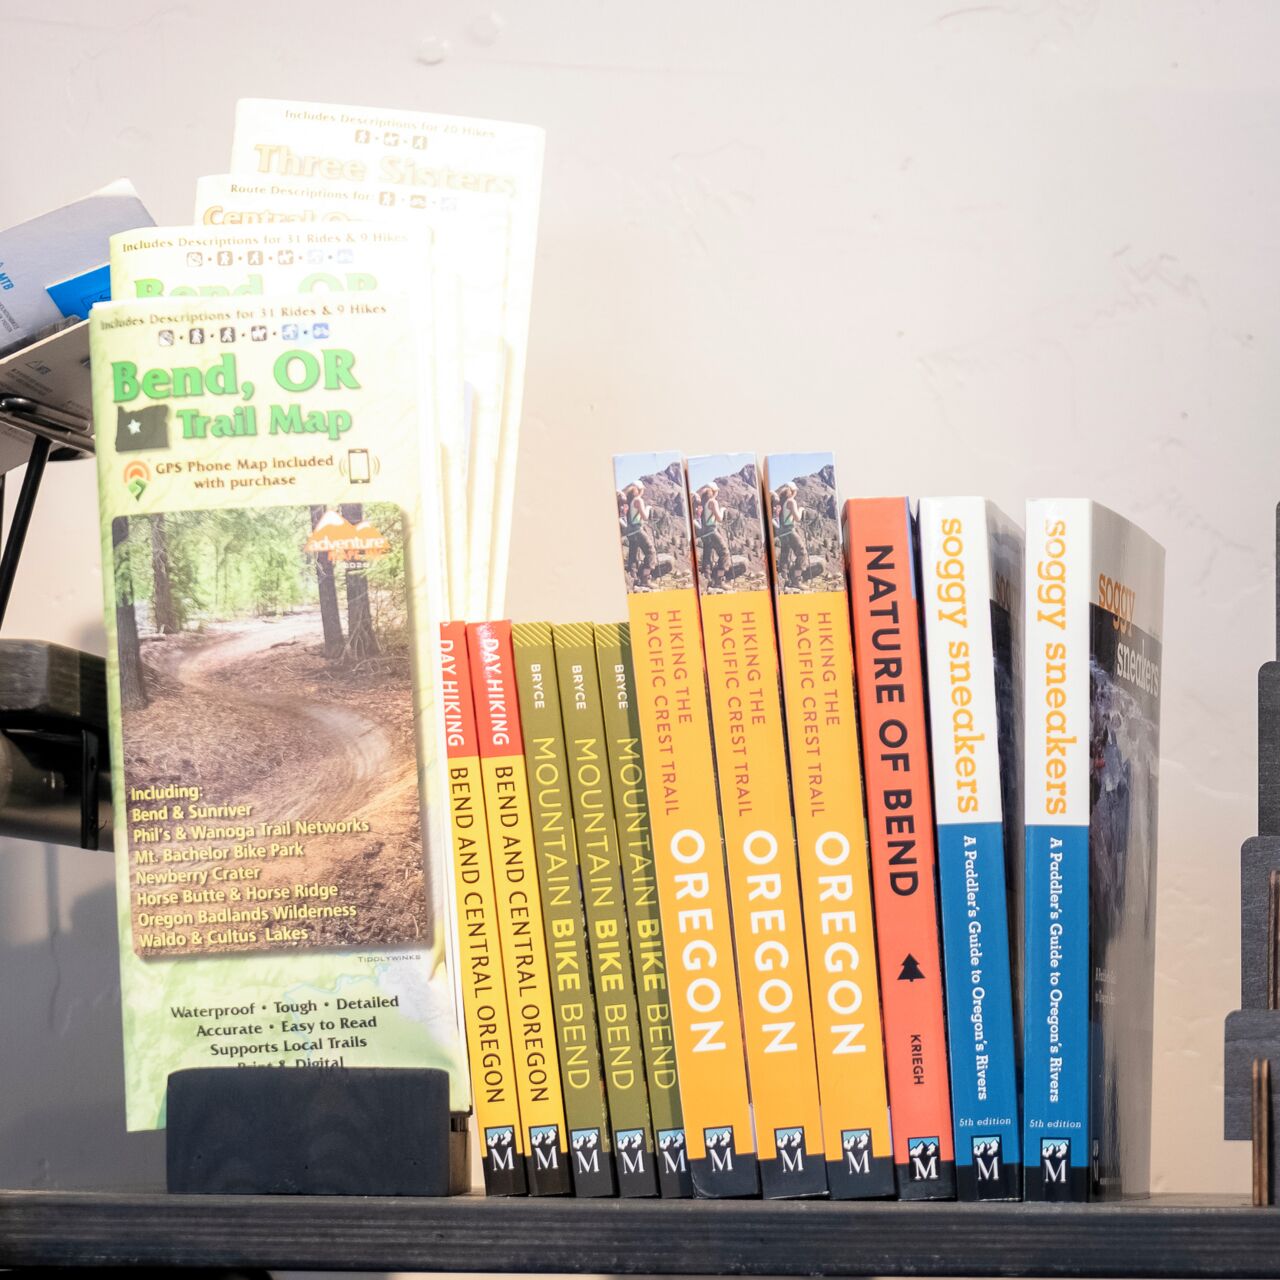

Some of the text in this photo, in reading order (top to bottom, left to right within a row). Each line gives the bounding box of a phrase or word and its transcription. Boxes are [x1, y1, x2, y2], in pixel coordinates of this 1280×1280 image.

[111, 348, 361, 403] Bend, OR
[176, 404, 352, 441] Trail Map
[156, 455, 334, 475] GPS Phone Map included
[194, 475, 295, 490] with purchase
[668, 610, 692, 723] HIKING THE
[936, 518, 985, 813] soggy sneakers
[1037, 520, 1077, 815] soggy sneakers
[531, 664, 544, 709] BRYCE
[645, 613, 679, 816] PACIFIC CREST TRAIL
[865, 545, 918, 896] NATURE OF BEND
[131, 786, 203, 801] Including:
[132, 804, 252, 822] Bend & Sunriver
[134, 819, 369, 842] Phil's & Wanoga Trail Networks
[135, 842, 304, 864] Mt. Bachelor Bike Park
[440, 640, 504, 1103] DAY HIKING BEND AND CENTRAL OREGON
[136, 866, 261, 886] Newberry Crater
[137, 884, 338, 905] Horse Butte & Horse Ridge
[138, 903, 357, 928] Oregon Badlands Wilderness
[533, 737, 589, 1088] MOUNTAIN BIKE BEND
[139, 926, 308, 947] Waldo & Cultus Lakes
[670, 829, 726, 1053] OREGON
[815, 831, 866, 1055] OREGON
[963, 835, 987, 1100] A Paddler's Guide to Oregon's Rivers
[170, 995, 399, 1019] Waterproof Tough Detailed
[210, 1036, 367, 1058] Supports Local Trails
[910, 1034, 924, 1085] KRIEGH
[960, 1116, 1011, 1126] 5th edition
